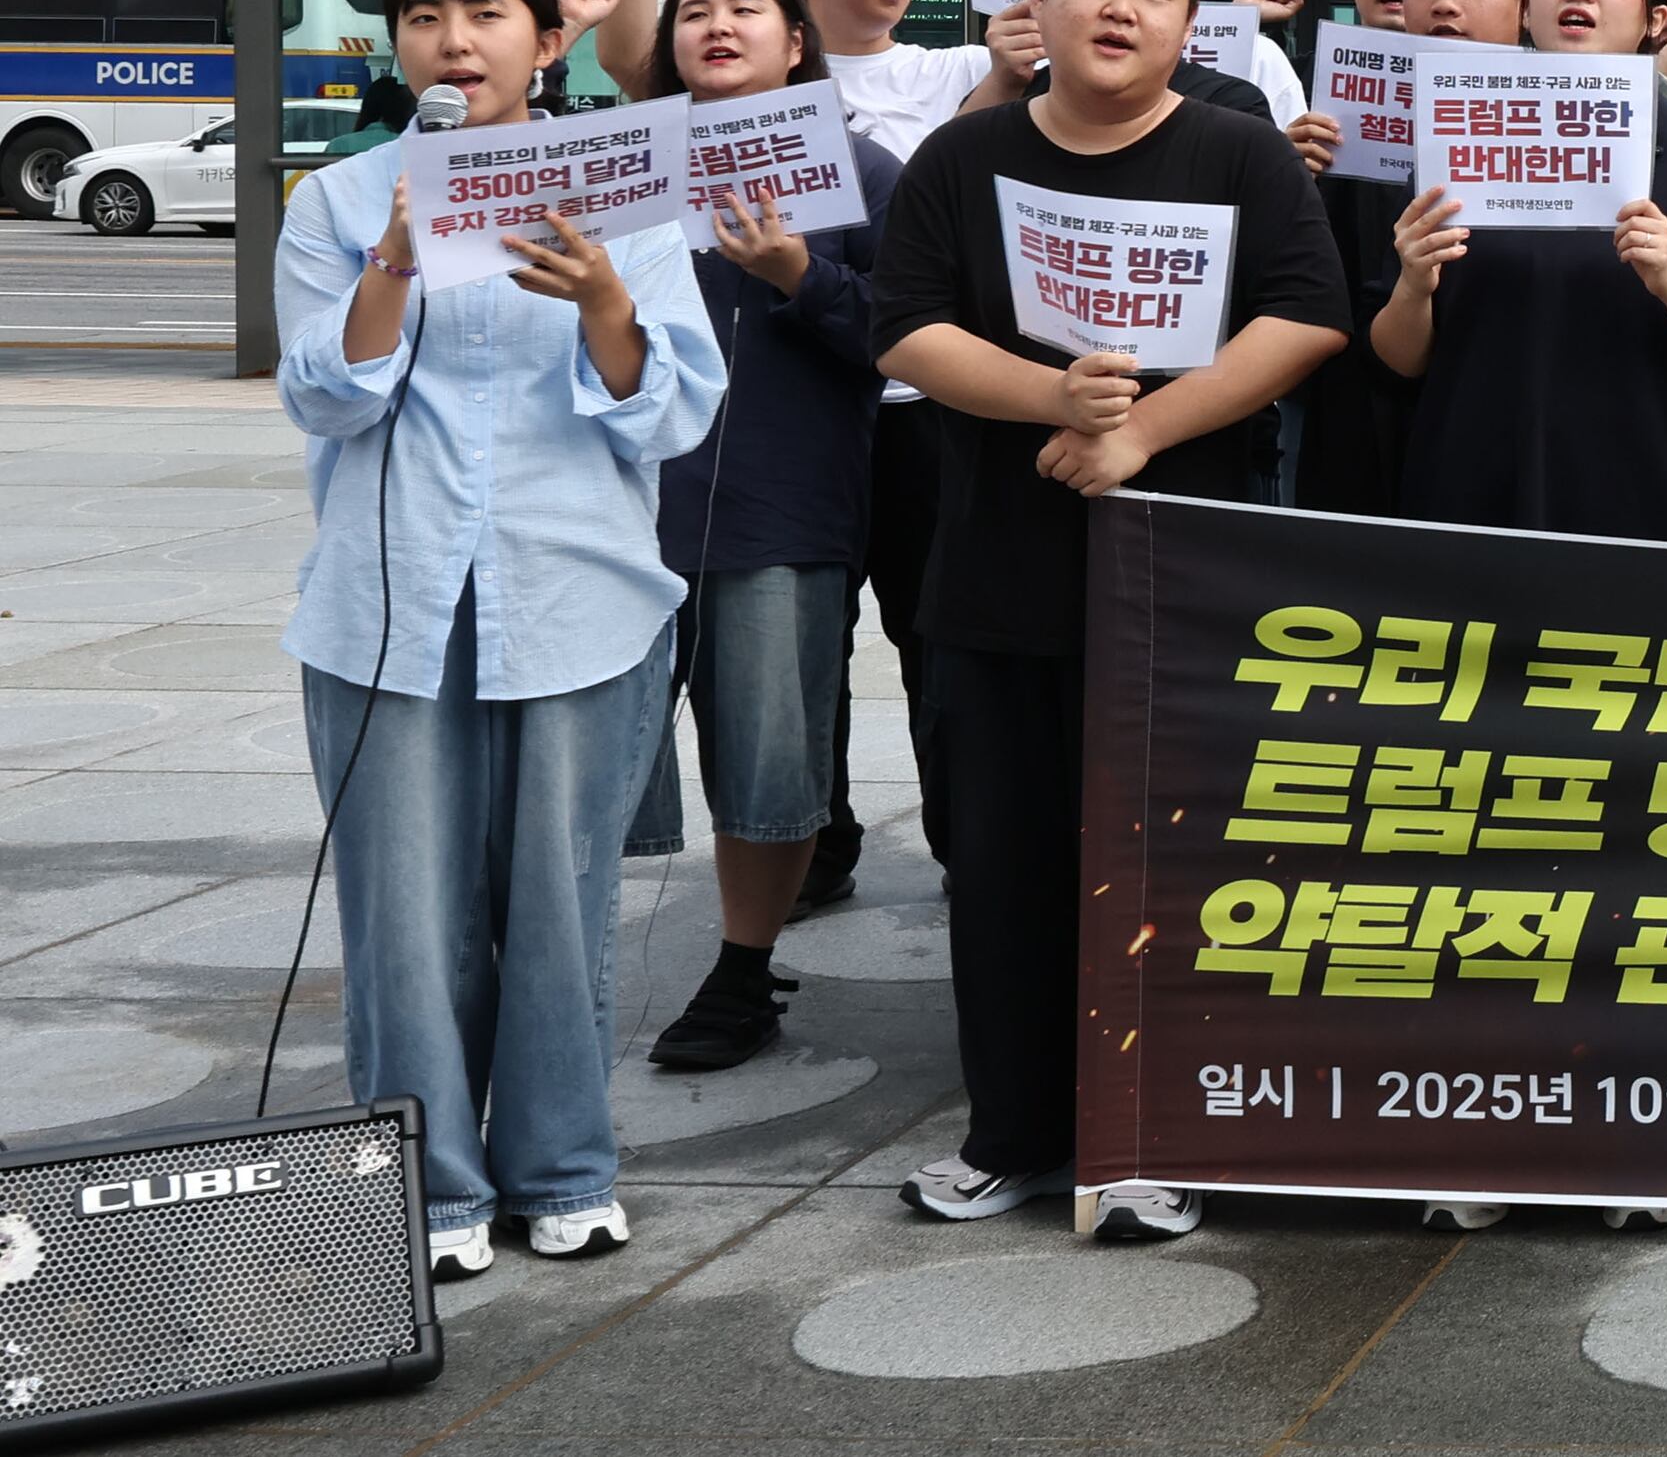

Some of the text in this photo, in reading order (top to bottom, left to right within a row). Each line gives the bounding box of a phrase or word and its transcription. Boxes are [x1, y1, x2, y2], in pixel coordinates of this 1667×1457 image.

[96, 62, 194, 85] POLICE
[1433, 75, 1456, 89] 우리
[1459, 75, 1484, 89] 국민
[1487, 75, 1512, 90] 불법
[1576, 76, 1601, 91] 사과
[1605, 77, 1631, 91] 않는
[1432, 99, 1633, 138] 트럼프 방한
[448, 127, 651, 170] 트럼프의 날강도적인
[1448, 145, 1612, 184] 반대한다!
[448, 150, 651, 203] 3500억 달러
[431, 176, 669, 238] 투자 강요 중단하라!
[1015, 202, 1035, 219] 우리
[1036, 207, 1058, 227] 국민
[1060, 212, 1085, 232] 불법
[1151, 224, 1179, 239] 사과
[1182, 225, 1209, 240] 않는
[1485, 197, 1574, 211] 한국대학생진보연합
[1019, 224, 1209, 287] 트럼프 방한
[1035, 271, 1182, 329] 반대한다!
[1234, 604, 1497, 723] 우리
[1222, 738, 1614, 857] 트럼프
[1195, 877, 1595, 1004] 약탈적
[1198, 1064, 1295, 1120] 일시
[1376, 1071, 1575, 1126] 2025년
[82, 1161, 282, 1215] CUBE
